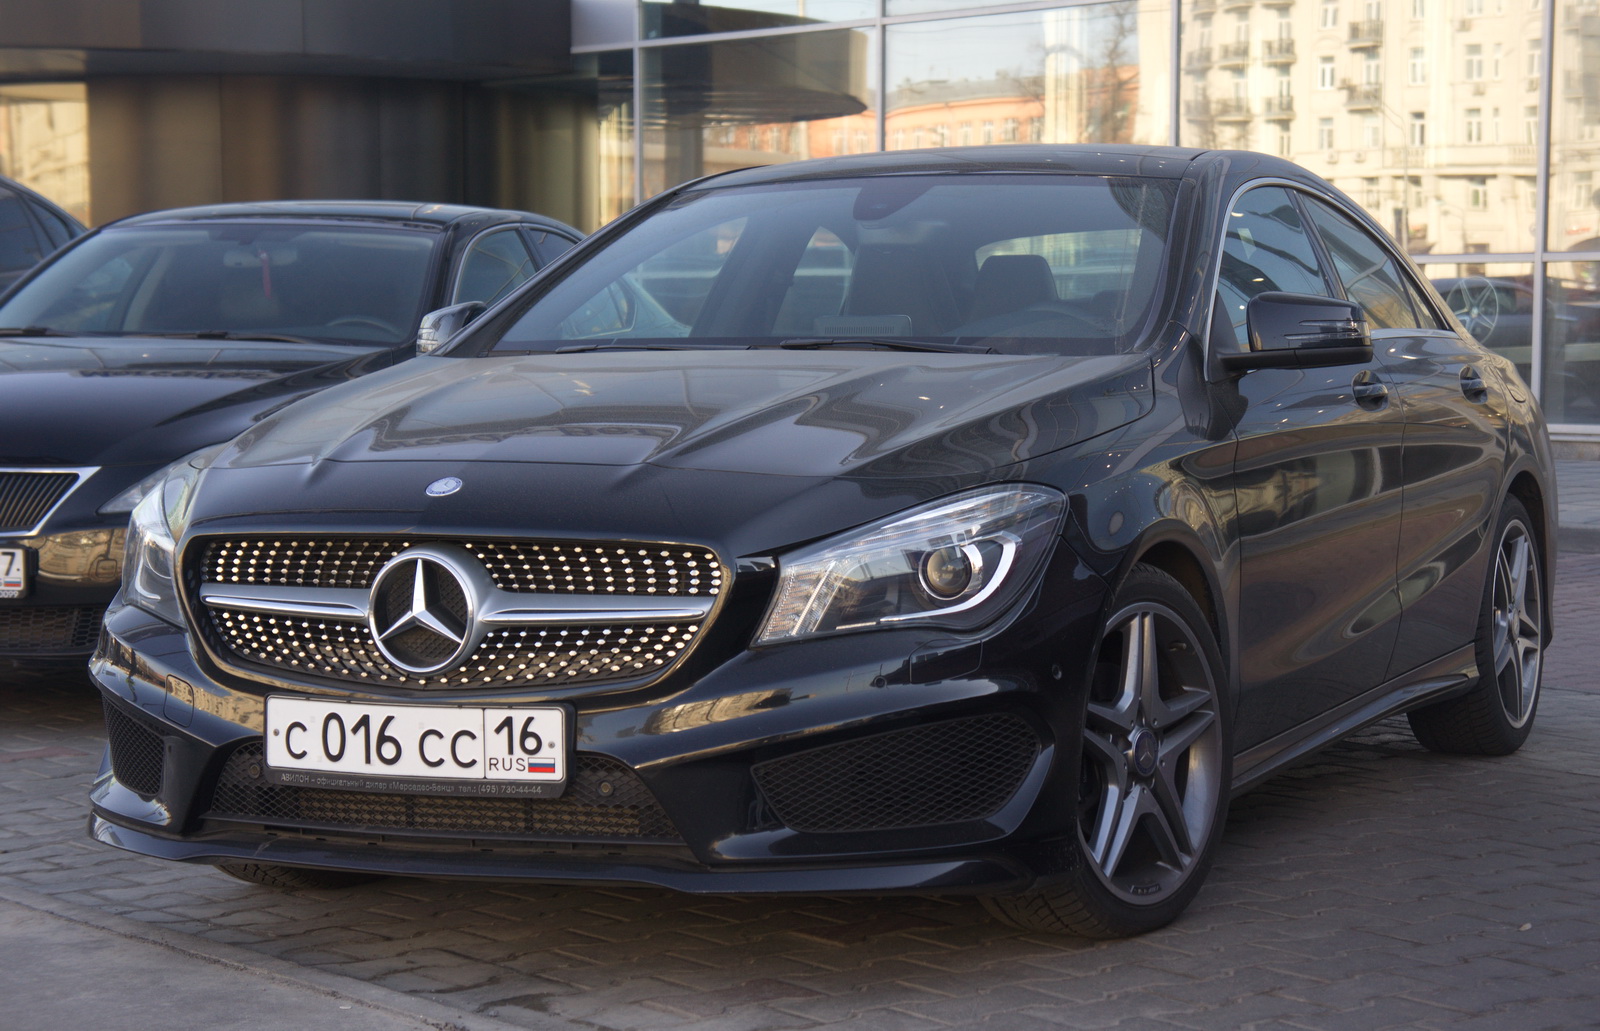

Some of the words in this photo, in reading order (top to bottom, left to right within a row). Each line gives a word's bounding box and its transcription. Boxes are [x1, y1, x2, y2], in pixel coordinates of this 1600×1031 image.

[321, 711, 403, 766] 016
[493, 715, 544, 756] 16
[488, 757, 526, 772] RUS
[478, 784, 499, 795] (495)
[500, 785, 542, 794] 730-44-44
